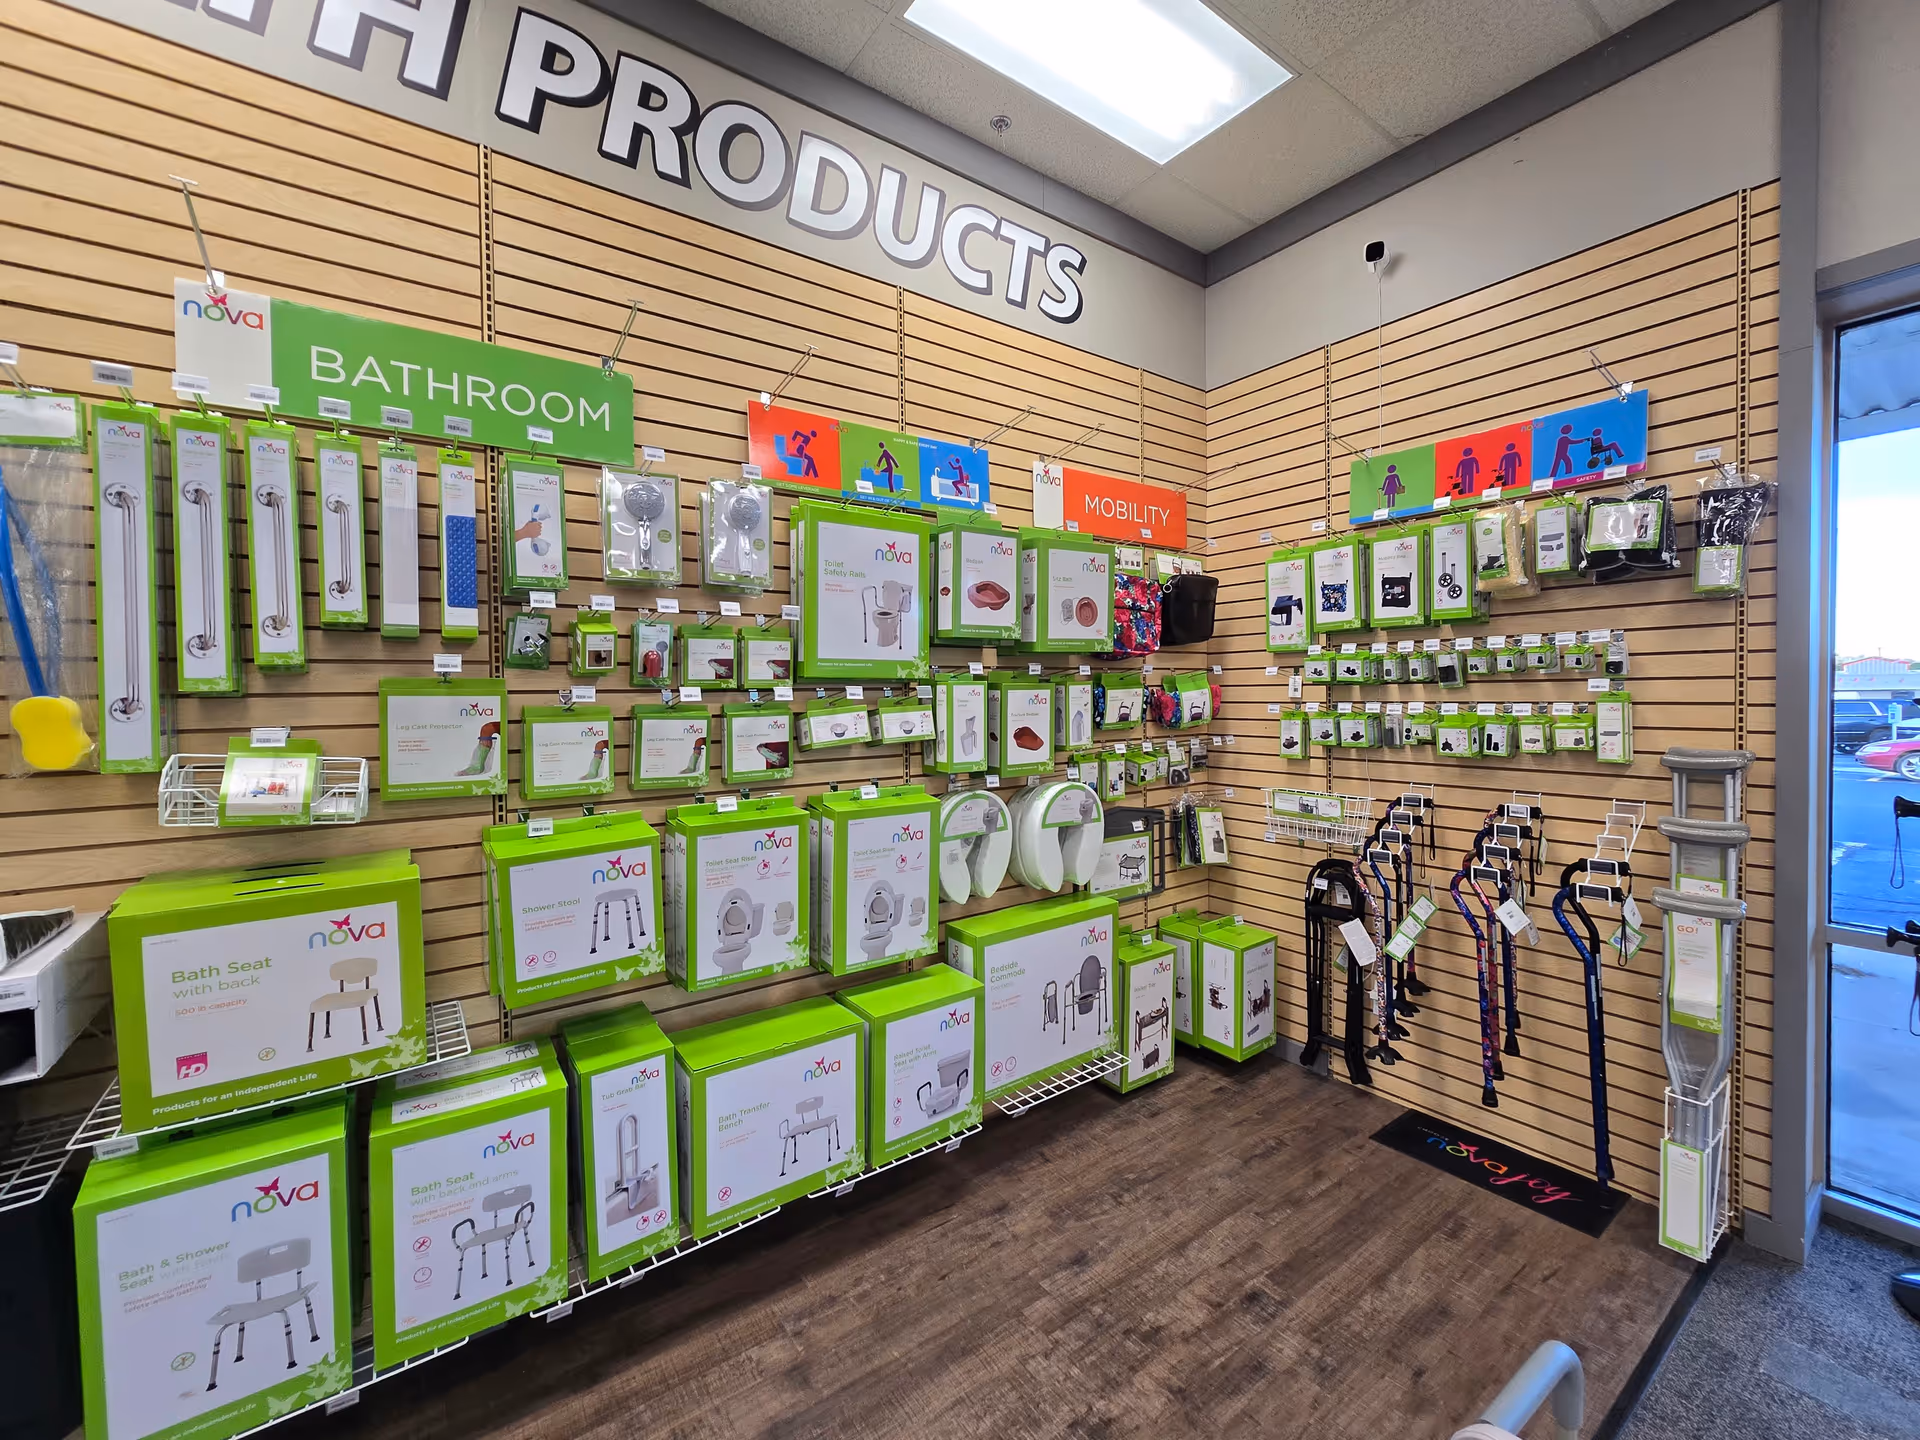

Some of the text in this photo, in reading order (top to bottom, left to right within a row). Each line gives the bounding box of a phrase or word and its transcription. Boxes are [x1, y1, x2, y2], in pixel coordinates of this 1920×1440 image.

[494, 5, 1088, 325] PRODUCTS
[183, 297, 264, 332] nova
[310, 345, 612, 432] BATHROOM
[107, 427, 141, 439] nova
[829, 423, 849, 434] nova
[185, 435, 215, 448] nova
[257, 444, 286, 455] nova
[327, 456, 354, 467] nova
[389, 465, 413, 475] nova
[450, 472, 473, 481] nova
[539, 478, 557, 486] nova
[1036, 473, 1061, 487] nova
[1575, 474, 1597, 483] SAFETY
[1085, 494, 1170, 526] MOBILITY
[1446, 528, 1463, 536] nova
[990, 545, 1013, 556] nova
[1394, 543, 1412, 551] nova
[875, 548, 912, 564] nova
[1332, 552, 1349, 560] nova
[824, 560, 845, 569] Toilet
[1082, 562, 1106, 574] nova
[1285, 564, 1303, 572] nova
[824, 568, 866, 579] Safety Rails
[717, 642, 731, 650] nova
[460, 707, 493, 717] nova
[892, 829, 924, 843] nova
[754, 836, 792, 852] nova
[592, 862, 647, 884] nova
[522, 898, 581, 914] Shower Stool
[308, 920, 387, 950] nova
[1080, 930, 1108, 948] nova
[171, 957, 273, 984] Bath Seat
[990, 961, 1019, 974] Bedside
[1153, 963, 1171, 976] nova
[990, 968, 1026, 983] Commode
[172, 974, 260, 999] with back
[517, 984, 543, 994] Products
[176, 1007, 196, 1016] 500
[208, 998, 248, 1010] capacity
[940, 1012, 970, 1032] nova
[178, 1063, 206, 1080] HD
[631, 1069, 660, 1085] nova
[804, 1058, 842, 1083] nova
[152, 1073, 318, 1116] Products for an Independent Life
[602, 1092, 615, 1100] Tub
[616, 1086, 634, 1096] Grab
[718, 1101, 771, 1125] Bath Transfer
[718, 1118, 744, 1133] Bench
[483, 1131, 535, 1159] nova
[1426, 1136, 1584, 1203] nova joy
[410, 1171, 475, 1196] Bath Seat
[411, 1170, 519, 1206] with back and arms
[230, 1180, 320, 1223] nova
[118, 1240, 231, 1282] Bath & Shower
[119, 1275, 154, 1293] Seat
[488, 1301, 501, 1310] Life
